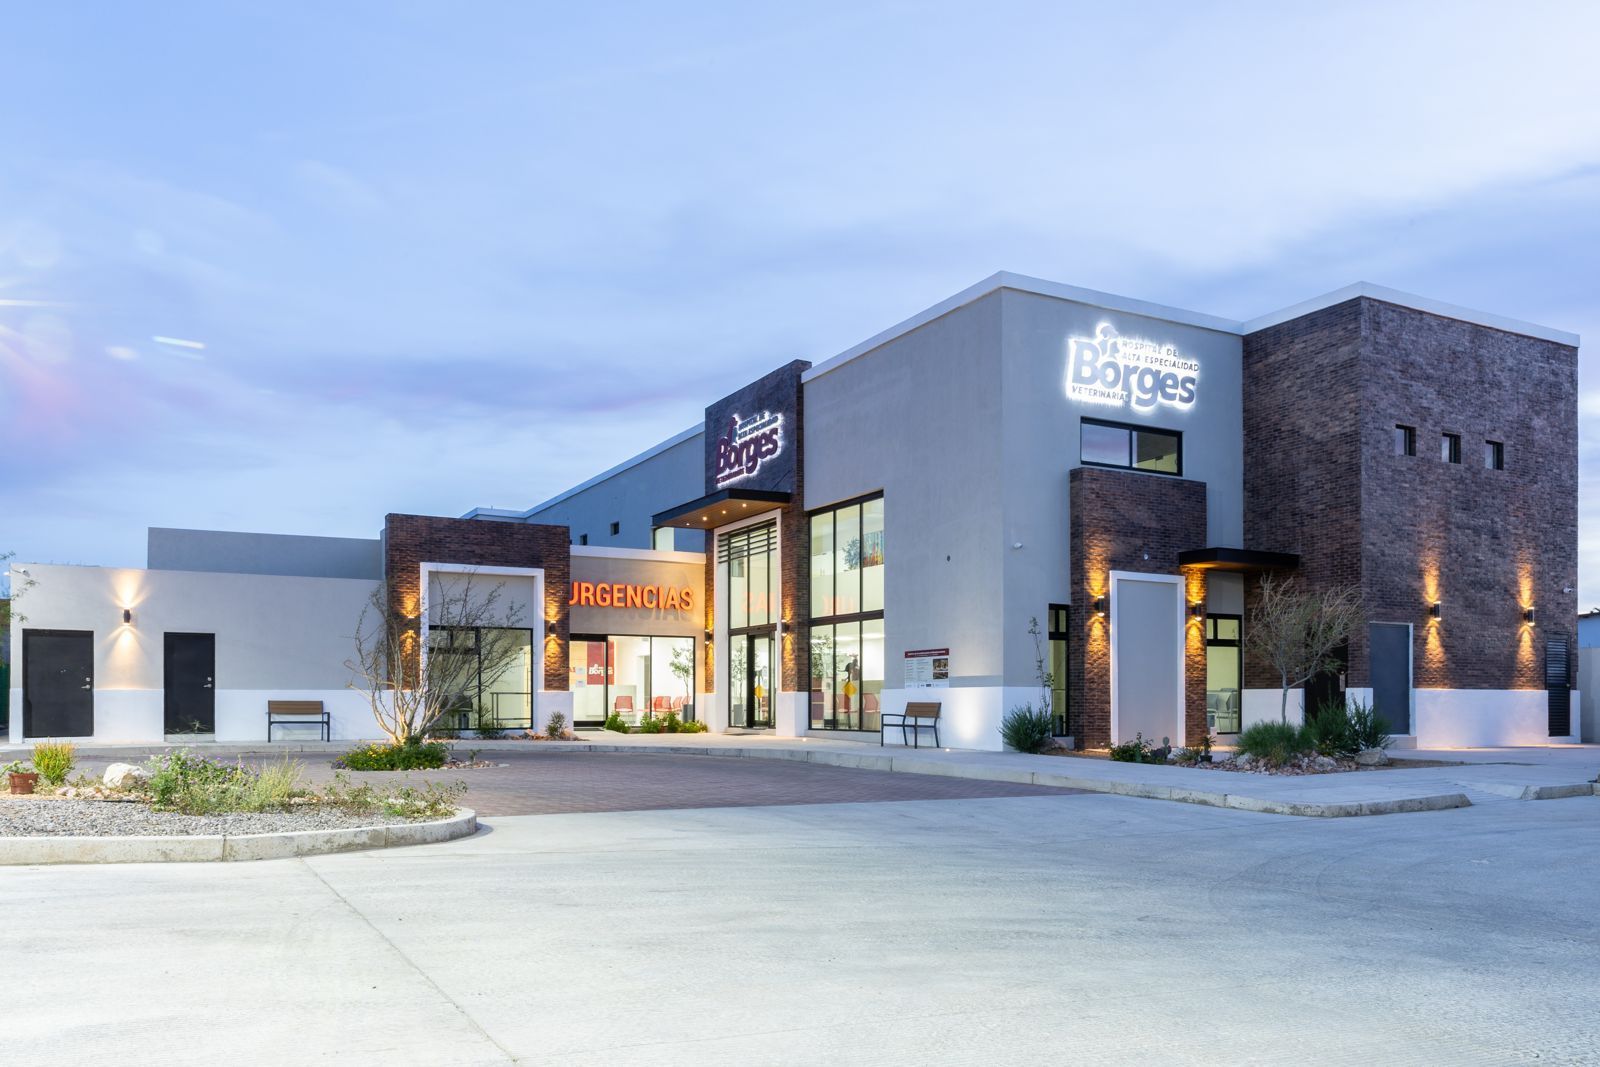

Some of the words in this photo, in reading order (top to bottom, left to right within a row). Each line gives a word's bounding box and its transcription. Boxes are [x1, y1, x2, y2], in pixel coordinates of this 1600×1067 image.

[1121, 340, 1161, 355] HOSPITAL
[1166, 348, 1178, 358] DE
[1121, 352, 1141, 361] ALTA
[1144, 355, 1199, 372] ESPECIALIDAD
[1072, 341, 1196, 407] Borges
[1072, 385, 1125, 400] VETERINARIA
[716, 428, 778, 475] Borges
